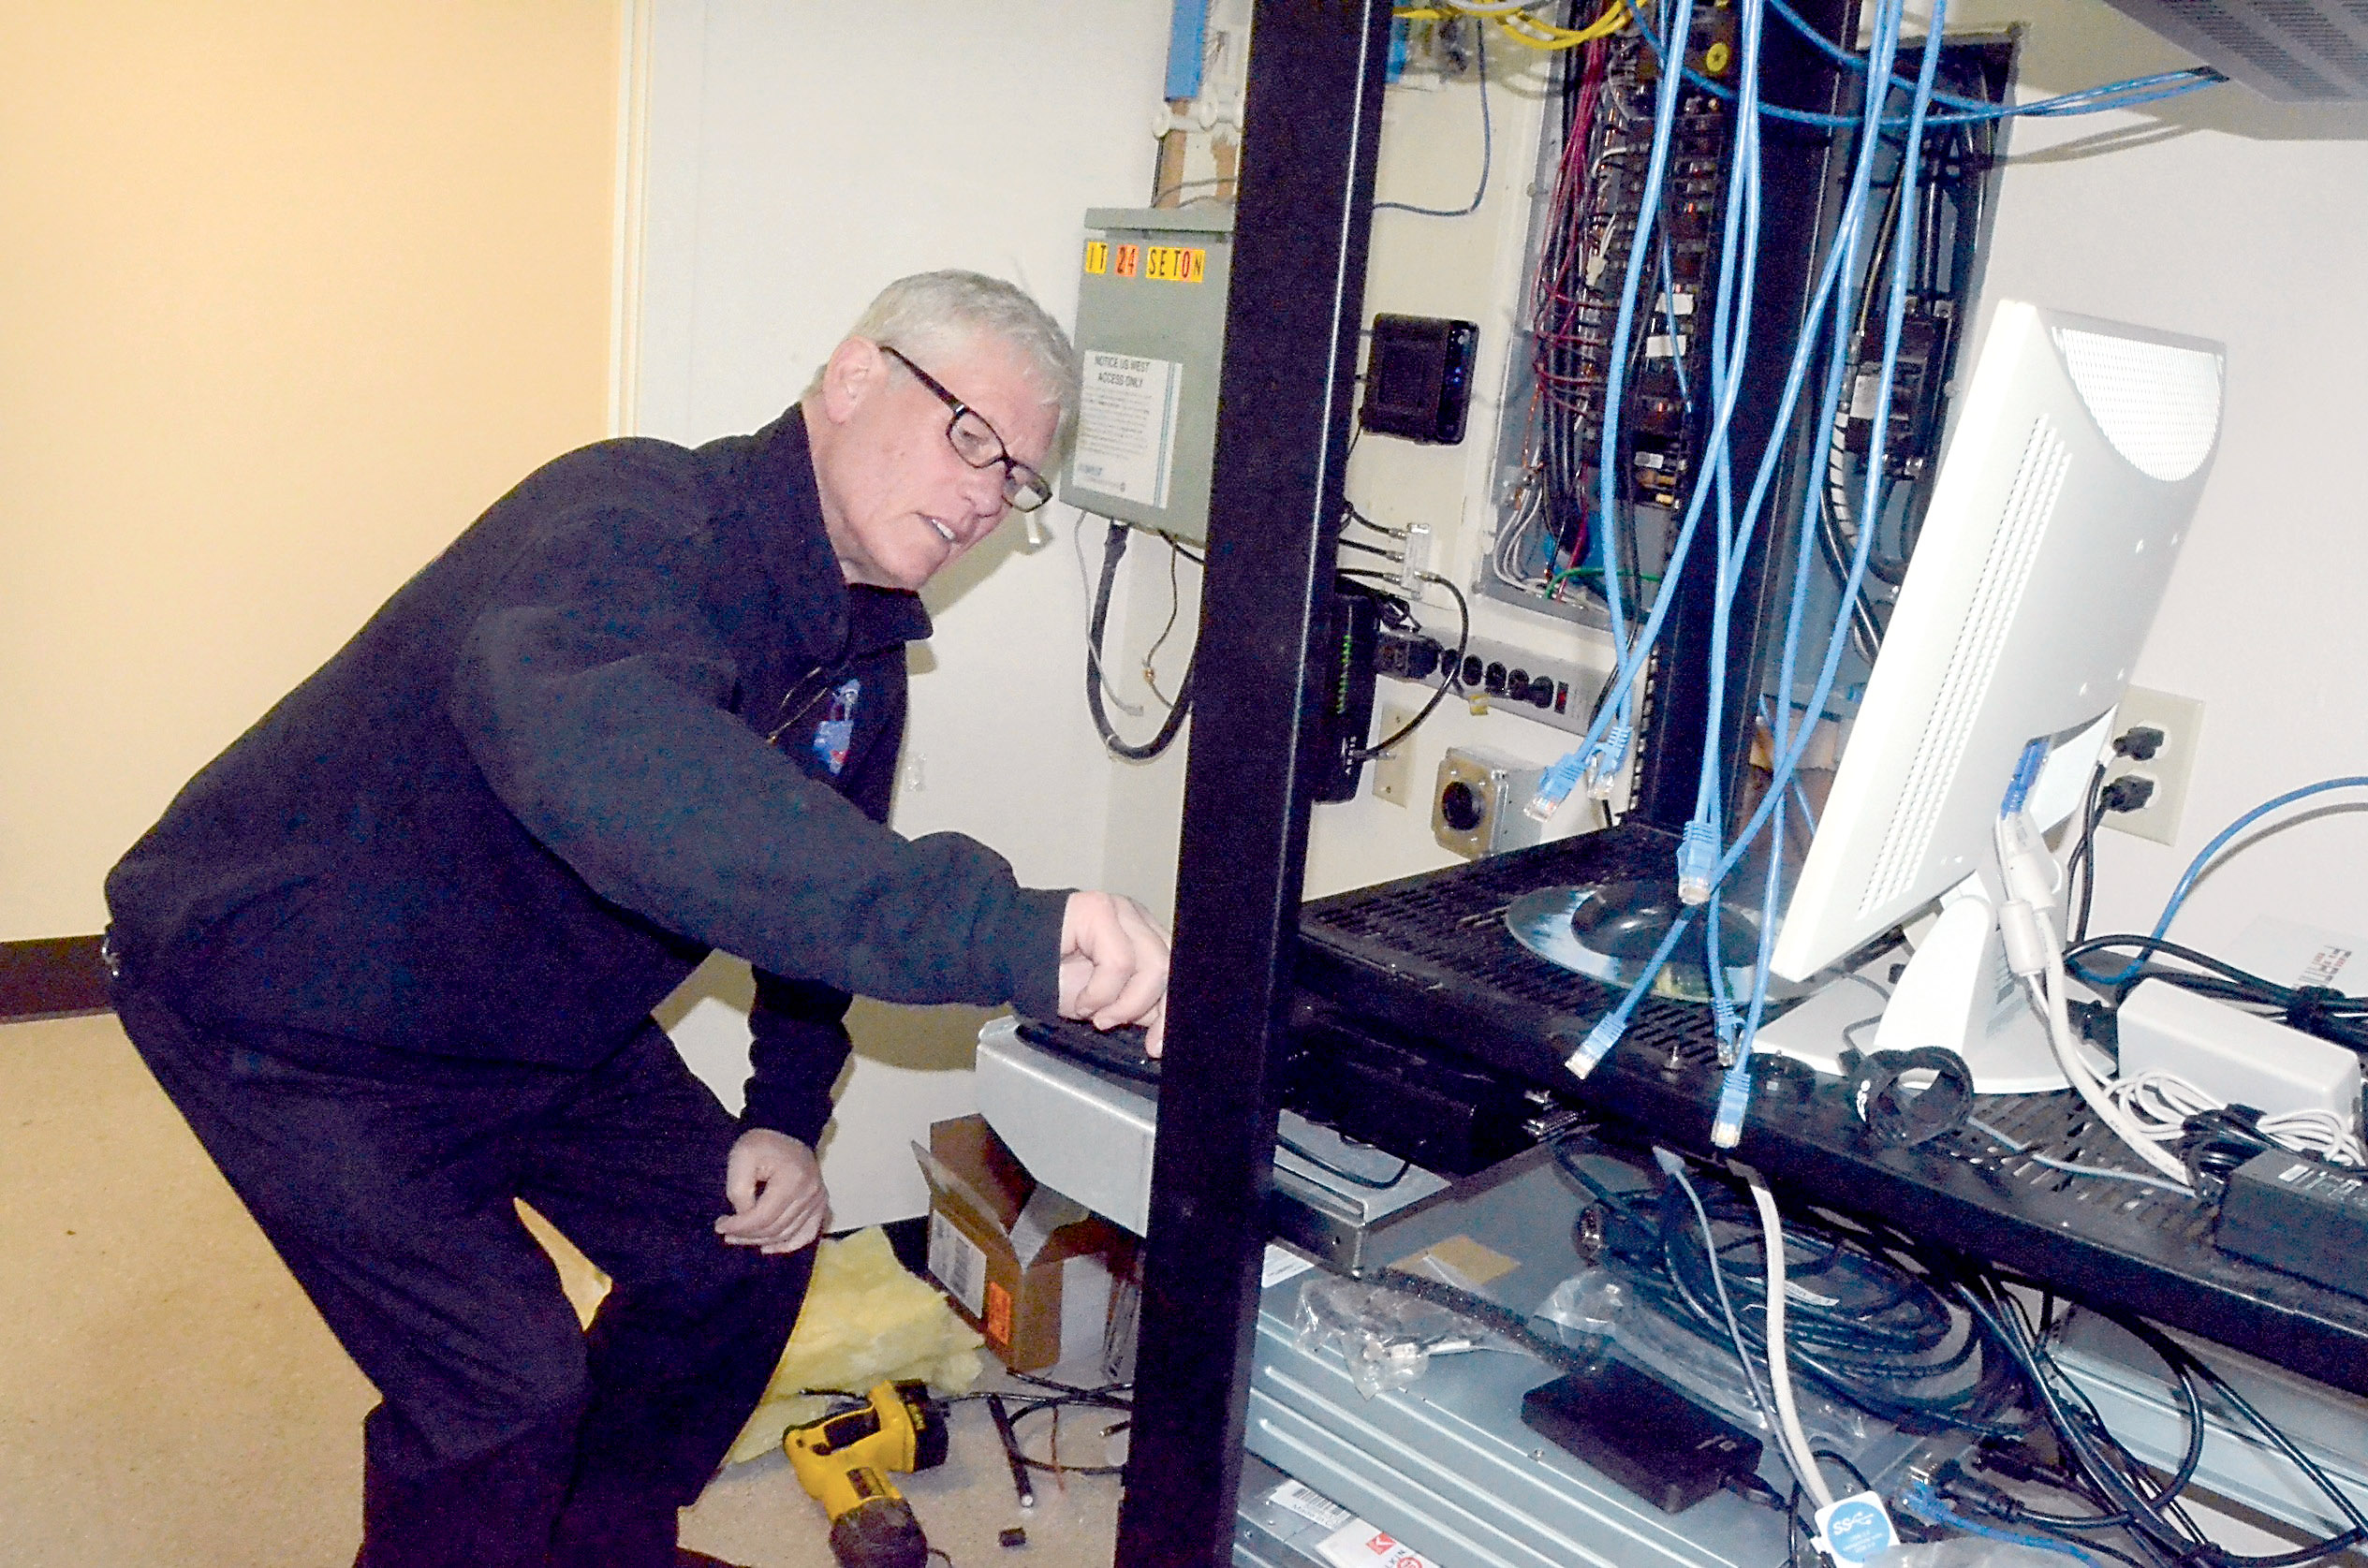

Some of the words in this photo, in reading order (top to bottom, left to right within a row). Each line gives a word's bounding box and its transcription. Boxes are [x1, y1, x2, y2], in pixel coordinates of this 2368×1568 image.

[1116, 246, 1136, 274] 24
[1148, 248, 1203, 278] SETON
[1094, 355, 1119, 369] NOTICE
[1097, 372, 1124, 387] ACCESS
[1125, 375, 1143, 388] ONLY
